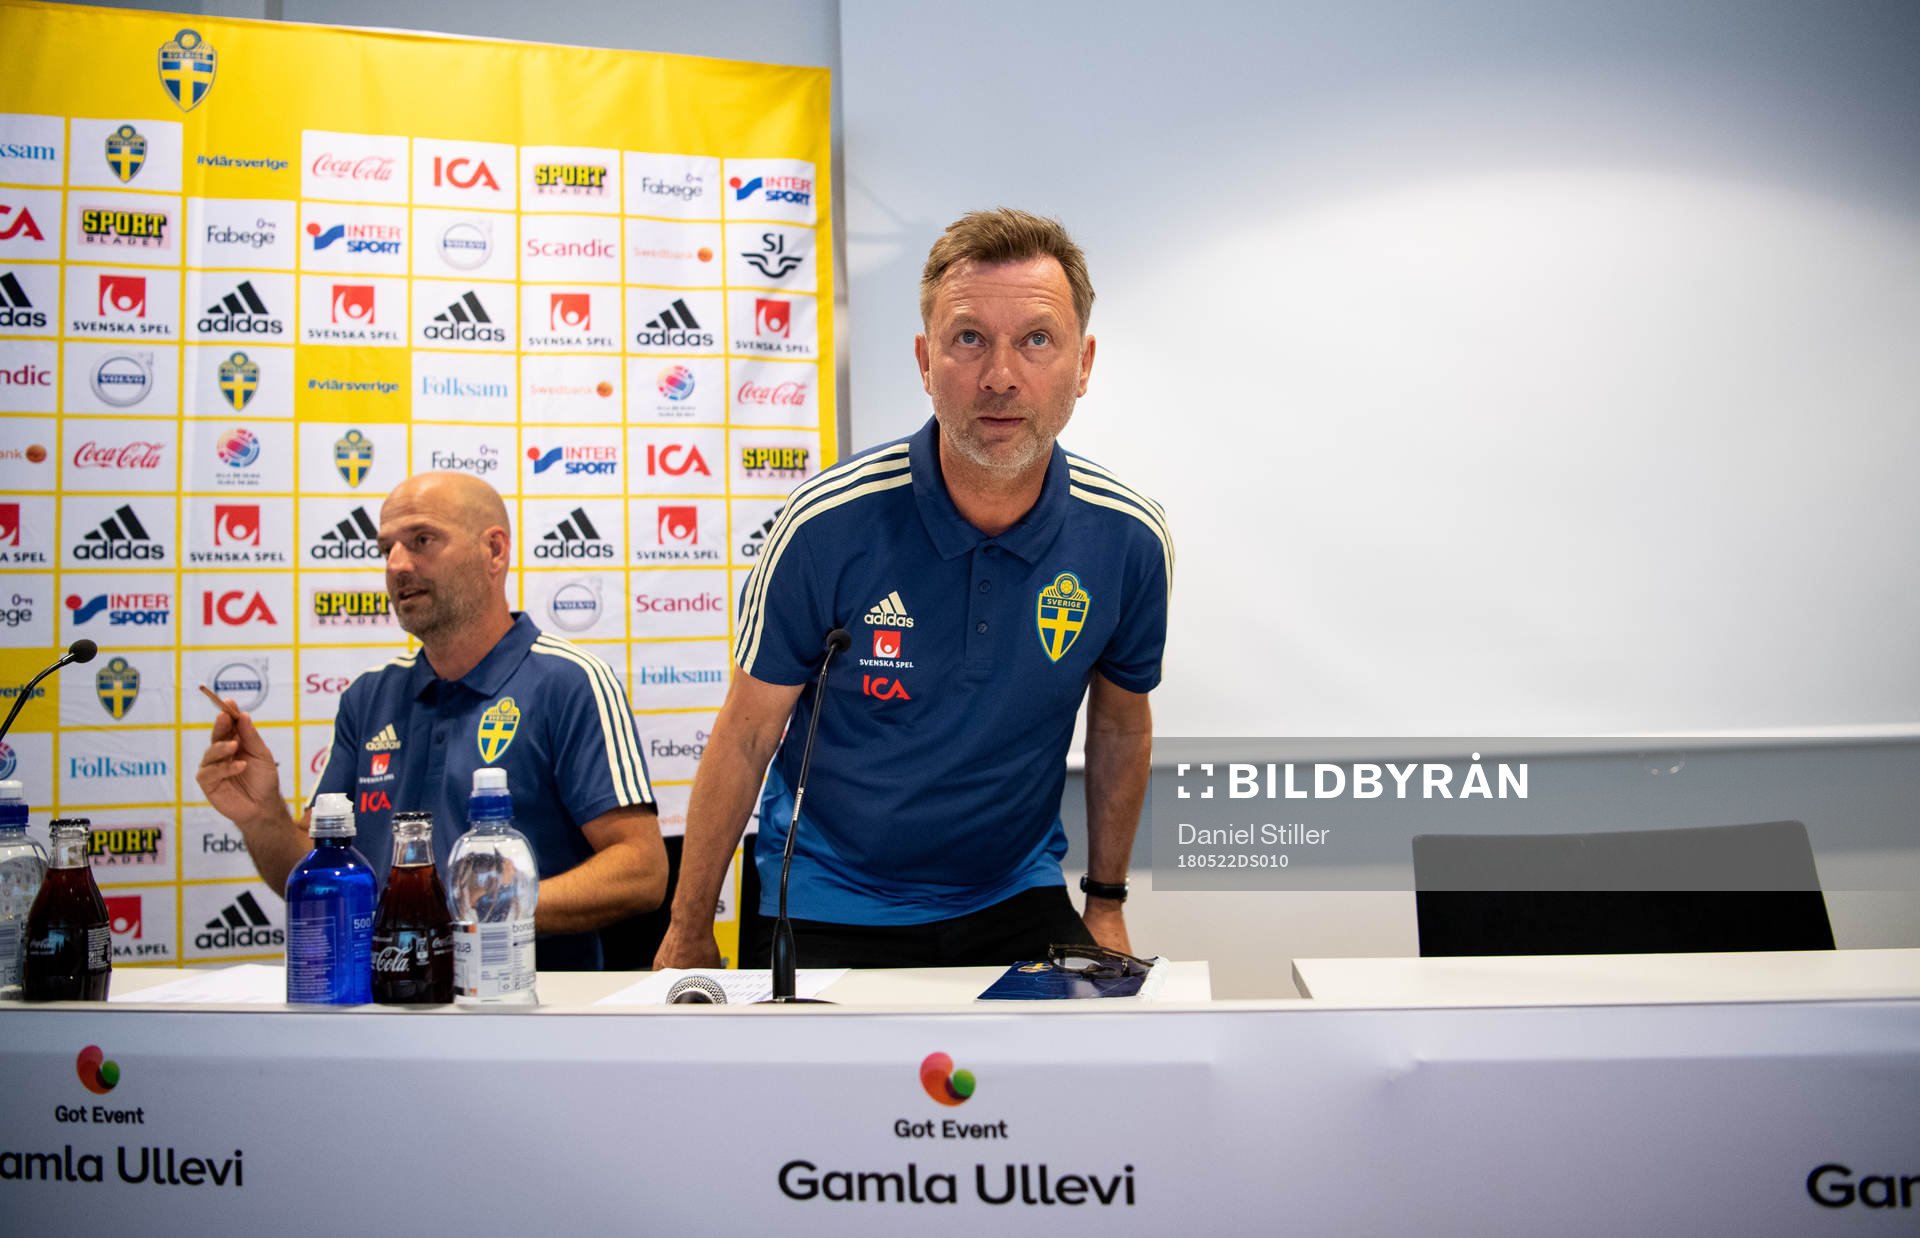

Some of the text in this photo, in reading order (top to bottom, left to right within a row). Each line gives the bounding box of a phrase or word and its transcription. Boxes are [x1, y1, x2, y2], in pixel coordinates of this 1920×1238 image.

[433, 156, 501, 191] ICA
[535, 163, 607, 188] SPORT
[765, 176, 811, 191] INTER
[642, 173, 703, 200] Fabege
[765, 190, 812, 206] SPORT
[82, 209, 167, 239] SPORT
[347, 224, 402, 239] INTER
[207, 225, 276, 249] Fabege
[347, 239, 402, 254] SPORT
[762, 233, 784, 255] SJ
[526, 238, 615, 259] Scandic
[73, 321, 171, 334] SVENSKA SPEL
[197, 311, 283, 335] adidas
[424, 322, 506, 342] adidas
[308, 329, 399, 341] SVENSKA SPEL
[529, 337, 614, 346] SVENSKA SPEL
[636, 326, 713, 347] adidas
[735, 340, 811, 354] SVENSKA SPEL
[422, 376, 508, 397] Folksam
[431, 450, 498, 475] Fabege
[565, 446, 617, 460] INTER
[648, 444, 712, 476] ICA
[742, 448, 810, 469] SPORT
[565, 461, 617, 475] SPORT
[13, 552, 47, 562] SPEL
[74, 537, 165, 561] adidas
[190, 551, 286, 562] SVENSKA SPEL
[311, 541, 381, 559] adida
[534, 538, 614, 559] adidas
[637, 550, 720, 560] SVENSKA SPEL
[110, 594, 169, 609] INTER
[203, 590, 278, 626] ICA
[314, 592, 390, 616] SPORT
[636, 593, 722, 614] Scandic
[1047, 597, 1082, 609] SVERIGE
[110, 610, 170, 626] SPORT
[864, 611, 914, 628] adidas
[859, 658, 914, 668] SVENSKA SPEL
[640, 666, 722, 685] Folksam
[863, 674, 912, 700] ICA
[651, 739, 704, 760] Fabeg
[70, 757, 167, 779] Folksam
[360, 791, 392, 813] ICA
[87, 828, 162, 855] PORT
[195, 926, 285, 949] adidas
[136, 944, 168, 956] SPEL
[55, 1105, 144, 1124] Got Event
[894, 1119, 1008, 1139] Got Event
[117, 1146, 243, 1187] Ullevi
[778, 1160, 1136, 1206] Gamla Ullevi
